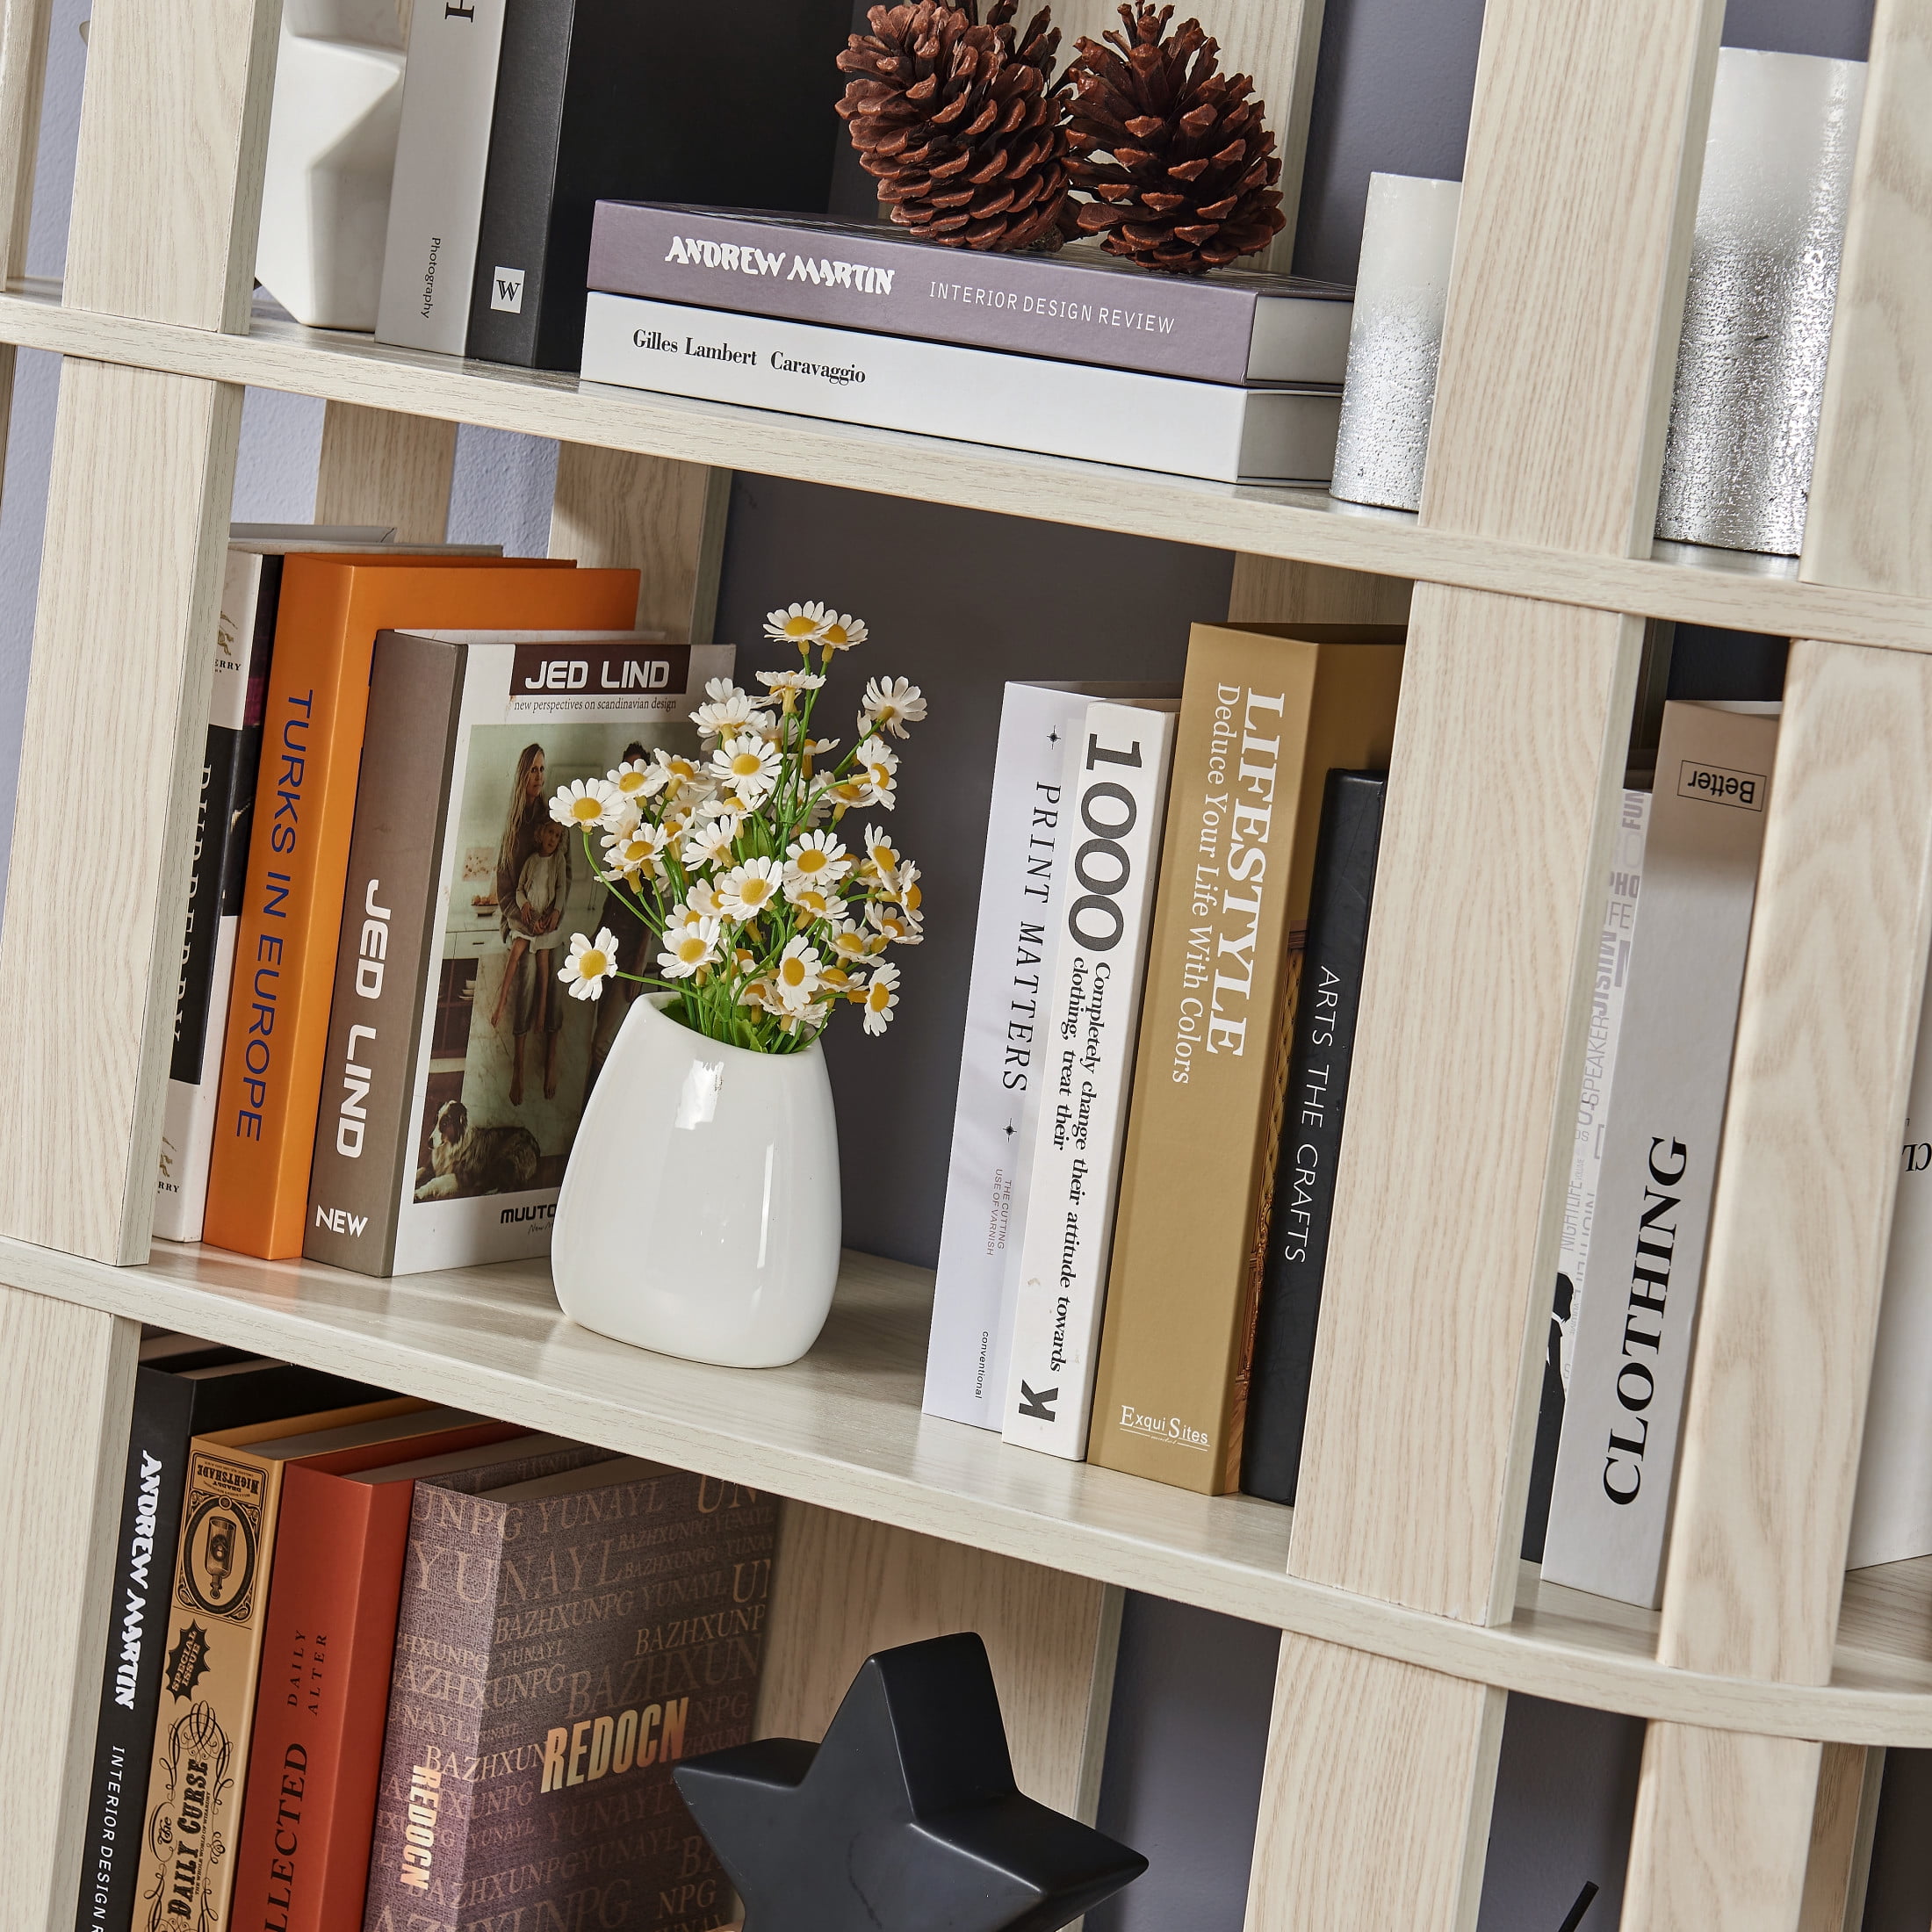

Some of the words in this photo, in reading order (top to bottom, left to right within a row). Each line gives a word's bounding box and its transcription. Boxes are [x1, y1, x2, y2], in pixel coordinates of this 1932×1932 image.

[421, 236, 442, 319] Photography
[496, 278, 522, 303] W
[664, 234, 787, 278] ANDREW
[787, 255, 895, 295] MARTIN
[929, 281, 1018, 310] INTERIOR
[1023, 296, 1092, 322] DESIGN
[1098, 306, 1175, 335] REVIEW
[632, 328, 679, 354] Gilles
[684, 336, 758, 367] Lambert
[770, 351, 867, 386] Caravaggio
[514, 702, 531, 710] new
[533, 697, 583, 714] perspectives
[584, 702, 596, 710] on
[596, 697, 650, 710] scandinavian
[651, 696, 676, 712] design
[525, 660, 589, 689] JED
[601, 660, 670, 688] LIND
[1207, 682, 1242, 785] Deduce
[271, 689, 314, 854] TURKS
[1687, 770, 1756, 804] Better
[1023, 781, 1062, 904] PRINT
[1068, 733, 1143, 952] 1000
[1197, 792, 1229, 858] Your
[263, 871, 292, 918] IN
[1191, 862, 1220, 917] Life
[1206, 687, 1286, 1056] LIFESTYLE
[355, 879, 393, 999] JED
[1182, 924, 1214, 990] With
[1003, 921, 1046, 1092] MATTERS
[1060, 956, 1086, 1041] clothing,
[1080, 962, 1112, 1075] Completely
[1312, 965, 1341, 1047] ARTS
[235, 934, 285, 1142] EUROPE
[1058, 1049, 1078, 1097] treat
[1171, 998, 1204, 1085] Colors
[337, 1024, 378, 1159] LIND
[1052, 1103, 1072, 1150] their
[1071, 1080, 1098, 1150] change
[1301, 1064, 1330, 1128] THE
[991, 1192, 1000, 1206] OF
[994, 1168, 1004, 1189] USE
[1003, 1179, 1013, 1200] THE
[1068, 1157, 1089, 1206] their
[1285, 1143, 1318, 1263] CRAFTS
[315, 1205, 369, 1238] NEW
[986, 1208, 998, 1257] VARNISH
[997, 1204, 1010, 1250] CUTTING
[1059, 1211, 1079, 1288] attitude
[1049, 1295, 1071, 1373] towards
[1603, 1135, 1688, 1505] CLOTHING
[975, 1330, 989, 1399] conventional
[197, 1464, 260, 1496] NIGHTSHADE
[212, 1480, 242, 1494] DEADLY
[129, 1449, 163, 1590] ANDREW
[114, 1588, 147, 1711] MARTIN
[171, 1631, 198, 1692] SPECIAL
[181, 1642, 201, 1687] ISSUE
[286, 1629, 306, 1707] DAILY
[307, 1634, 328, 1717] ALTER
[540, 1697, 689, 1794] REDOCN
[102, 1745, 126, 1842] INTERIOR
[177, 1758, 208, 1835] CURSE
[400, 1764, 442, 1891] REDOCN
[157, 1816, 173, 1846] The
[92, 1845, 113, 1920] DESIGN
[168, 1841, 199, 1921] DAILY
